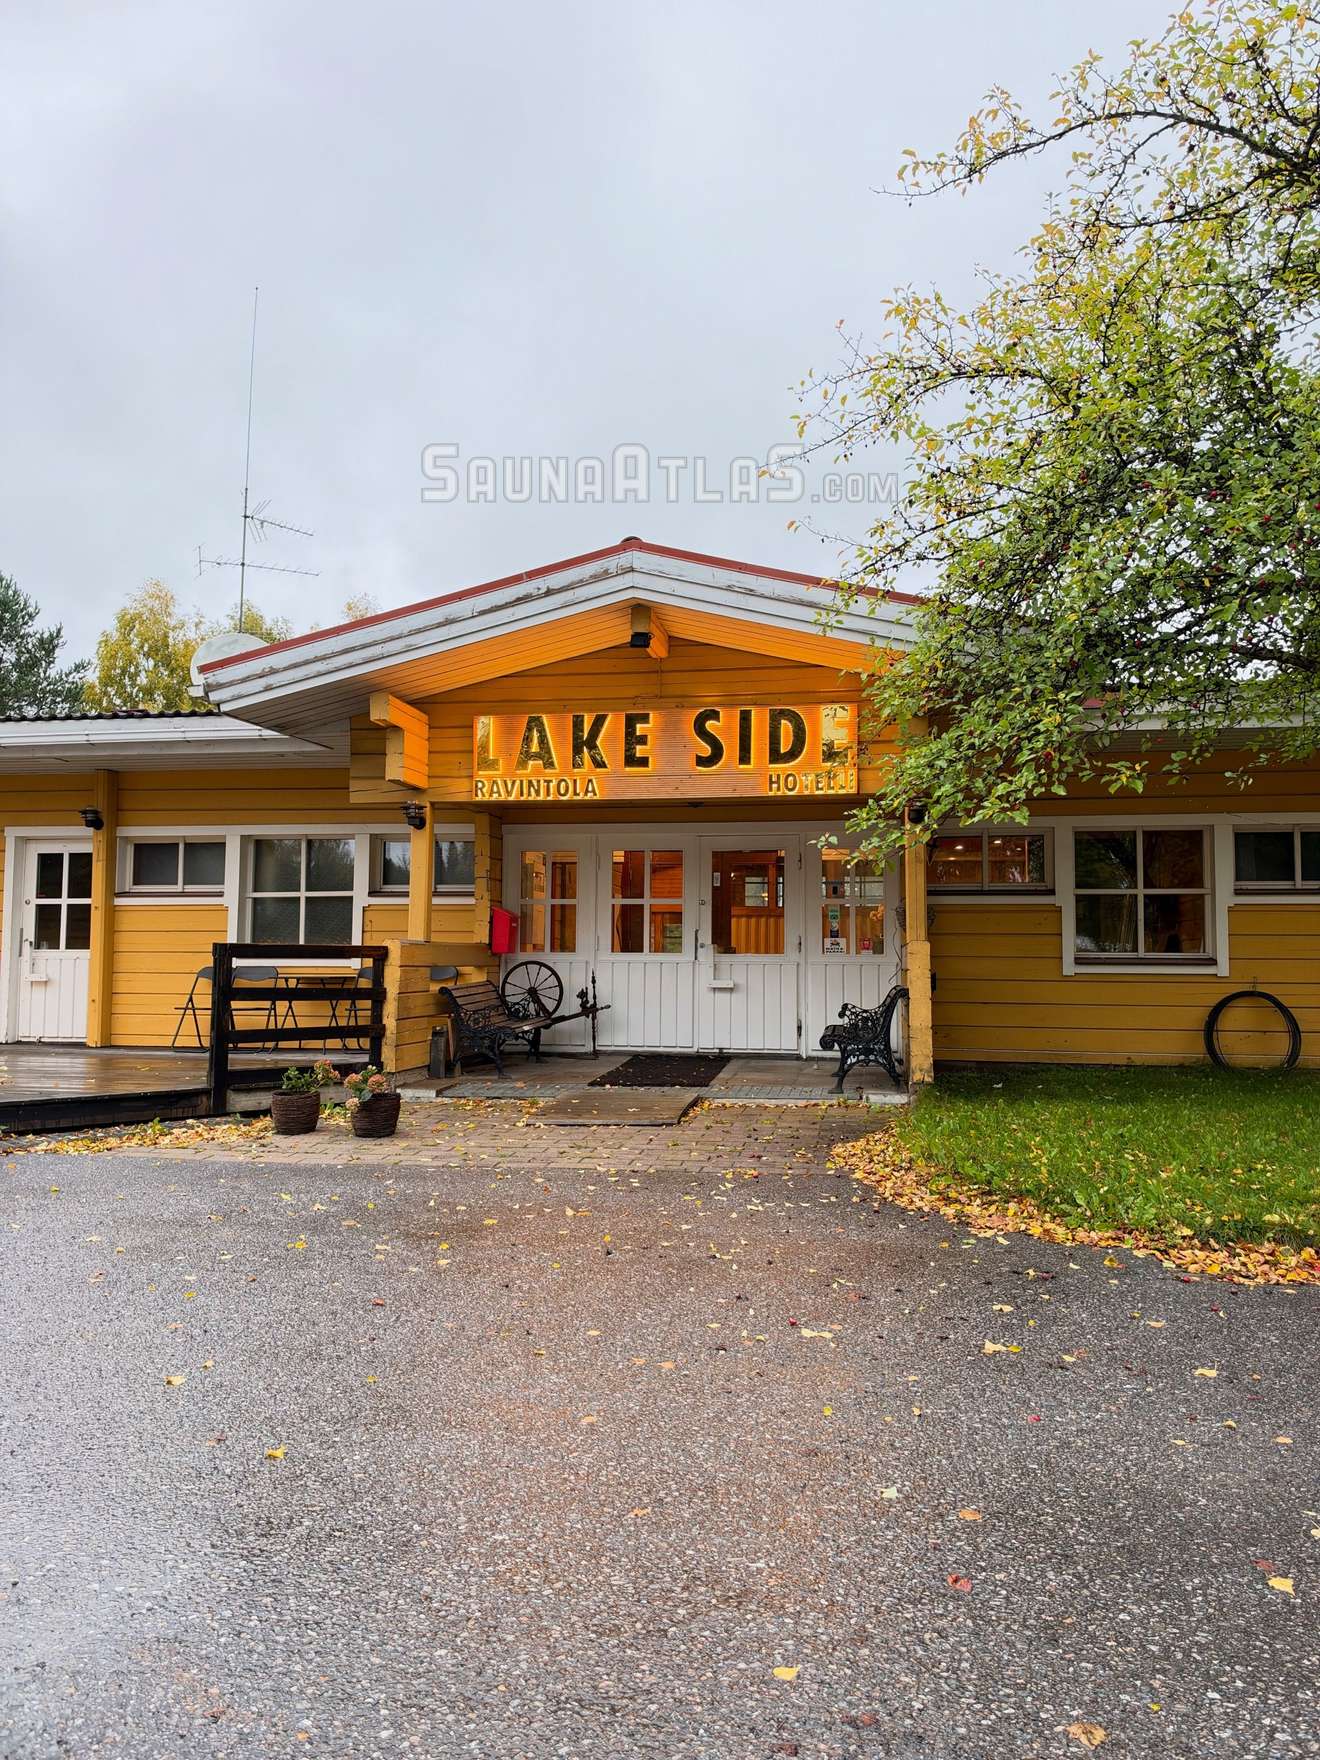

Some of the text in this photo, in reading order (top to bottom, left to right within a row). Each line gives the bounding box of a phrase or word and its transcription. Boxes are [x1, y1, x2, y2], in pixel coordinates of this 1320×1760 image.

[476, 705, 850, 772] LAKE SIDE
[474, 777, 600, 799] RAVINTOLA
